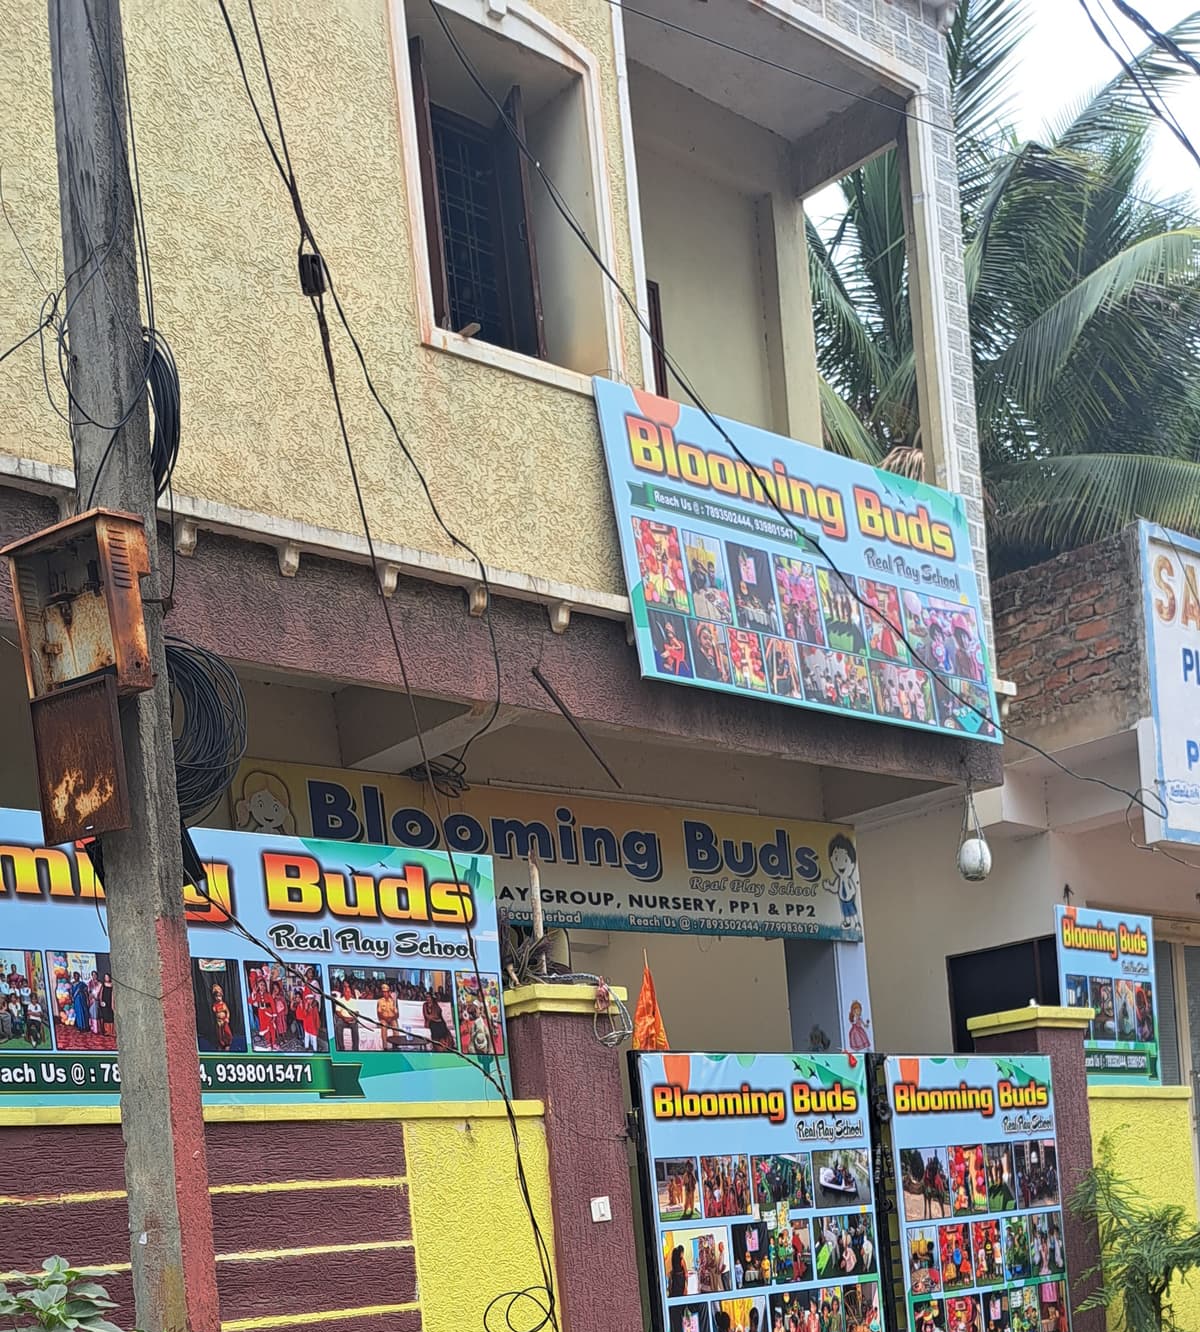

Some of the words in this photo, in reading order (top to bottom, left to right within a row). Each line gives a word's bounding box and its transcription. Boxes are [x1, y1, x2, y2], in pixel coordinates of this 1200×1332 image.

[625, 413, 847, 540] Blooming
[853, 485, 956, 561] Buds
[654, 490, 680, 507] Reach
[681, 499, 692, 511] Us
[864, 548, 893, 574] Real
[894, 556, 919, 584] Play
[921, 563, 961, 592] School
[306, 779, 662, 882] Blooming
[683, 819, 821, 883] Buds
[262, 851, 475, 924] Buds
[690, 877, 728, 892] Real
[730, 881, 766, 897] Play
[768, 882, 819, 897] School
[628, 894, 723, 914] NURSERY,
[729, 900, 759, 915] PP1
[768, 903, 780, 916] &
[785, 903, 816, 917] PP2
[268, 924, 331, 950] Real
[335, 927, 390, 959] Play
[394, 931, 477, 959] School
[629, 914, 660, 927] Reach
[663, 916, 676, 928] Us
[679, 916, 691, 931] @
[700, 919, 762, 932] 7893502444,
[764, 921, 820, 934] 7799836129
[1062, 916, 1118, 960] Blooming
[1119, 922, 1148, 956] Buds
[41, 1063, 67, 1083] Us
[71, 1063, 85, 1085] @
[216, 1063, 312, 1082] 9398015471
[653, 1084, 785, 1122] Blooming
[791, 1082, 858, 1113] Buds
[894, 1082, 994, 1117] Blooming
[998, 1080, 1048, 1108] Buds
[796, 1120, 817, 1140] Real
[816, 1120, 835, 1142] Play
[835, 1119, 864, 1137] School
